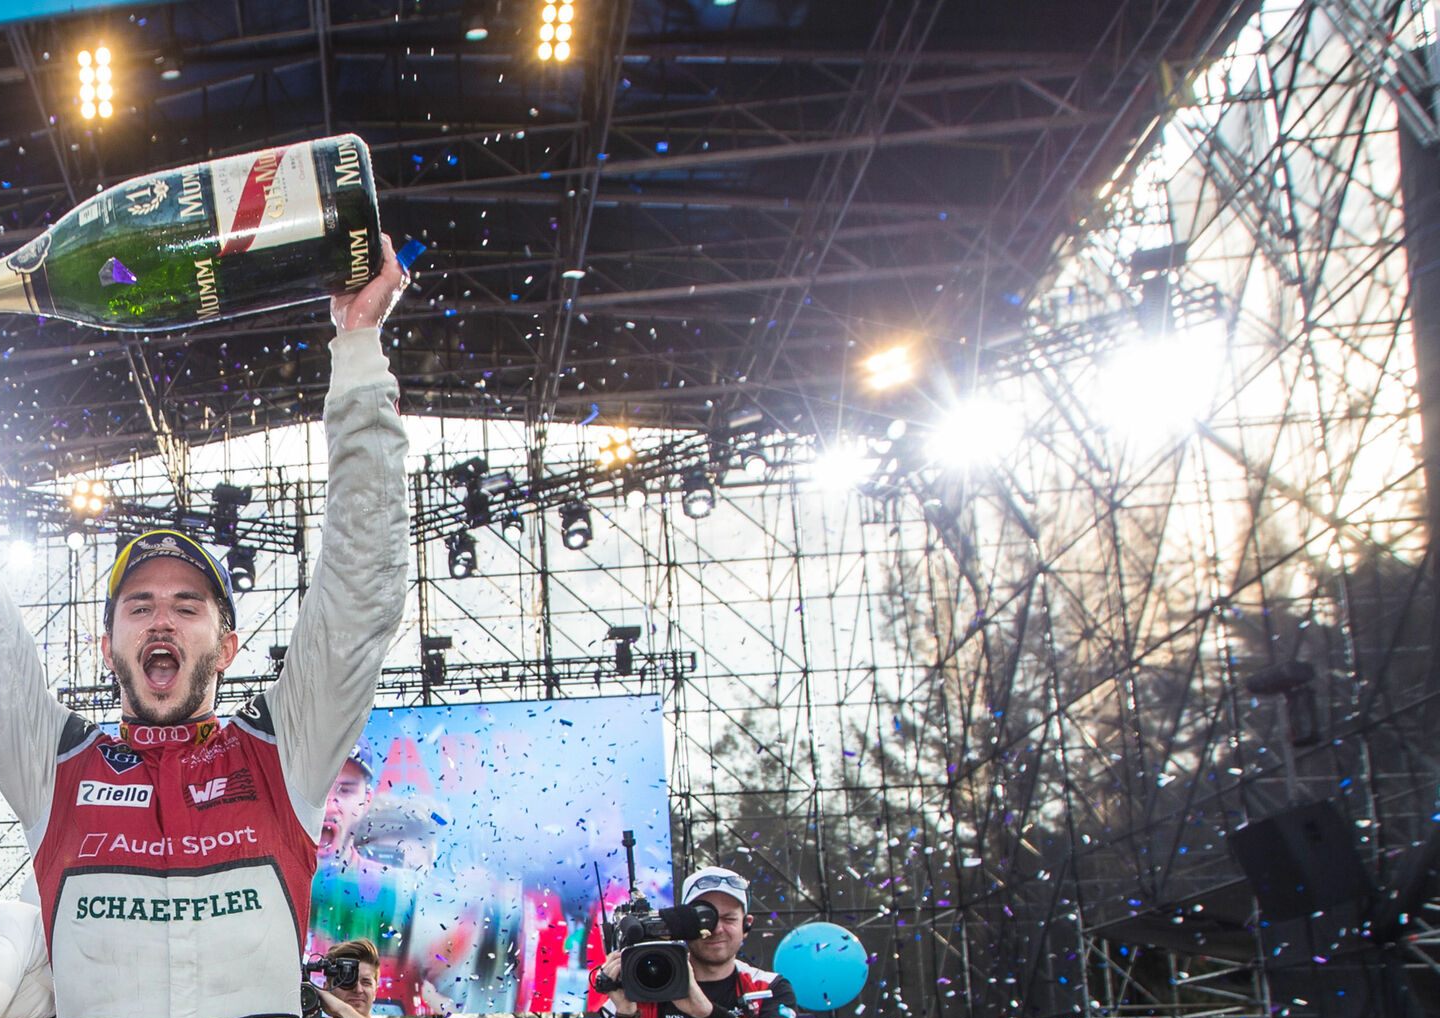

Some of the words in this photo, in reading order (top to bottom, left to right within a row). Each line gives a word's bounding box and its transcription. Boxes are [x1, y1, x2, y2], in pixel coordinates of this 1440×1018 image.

[188, 777, 228, 804] WE
[109, 833, 173, 856] Audi
[183, 825, 258, 857] Sport
[76, 888, 262, 921] SCHAEFFLER
